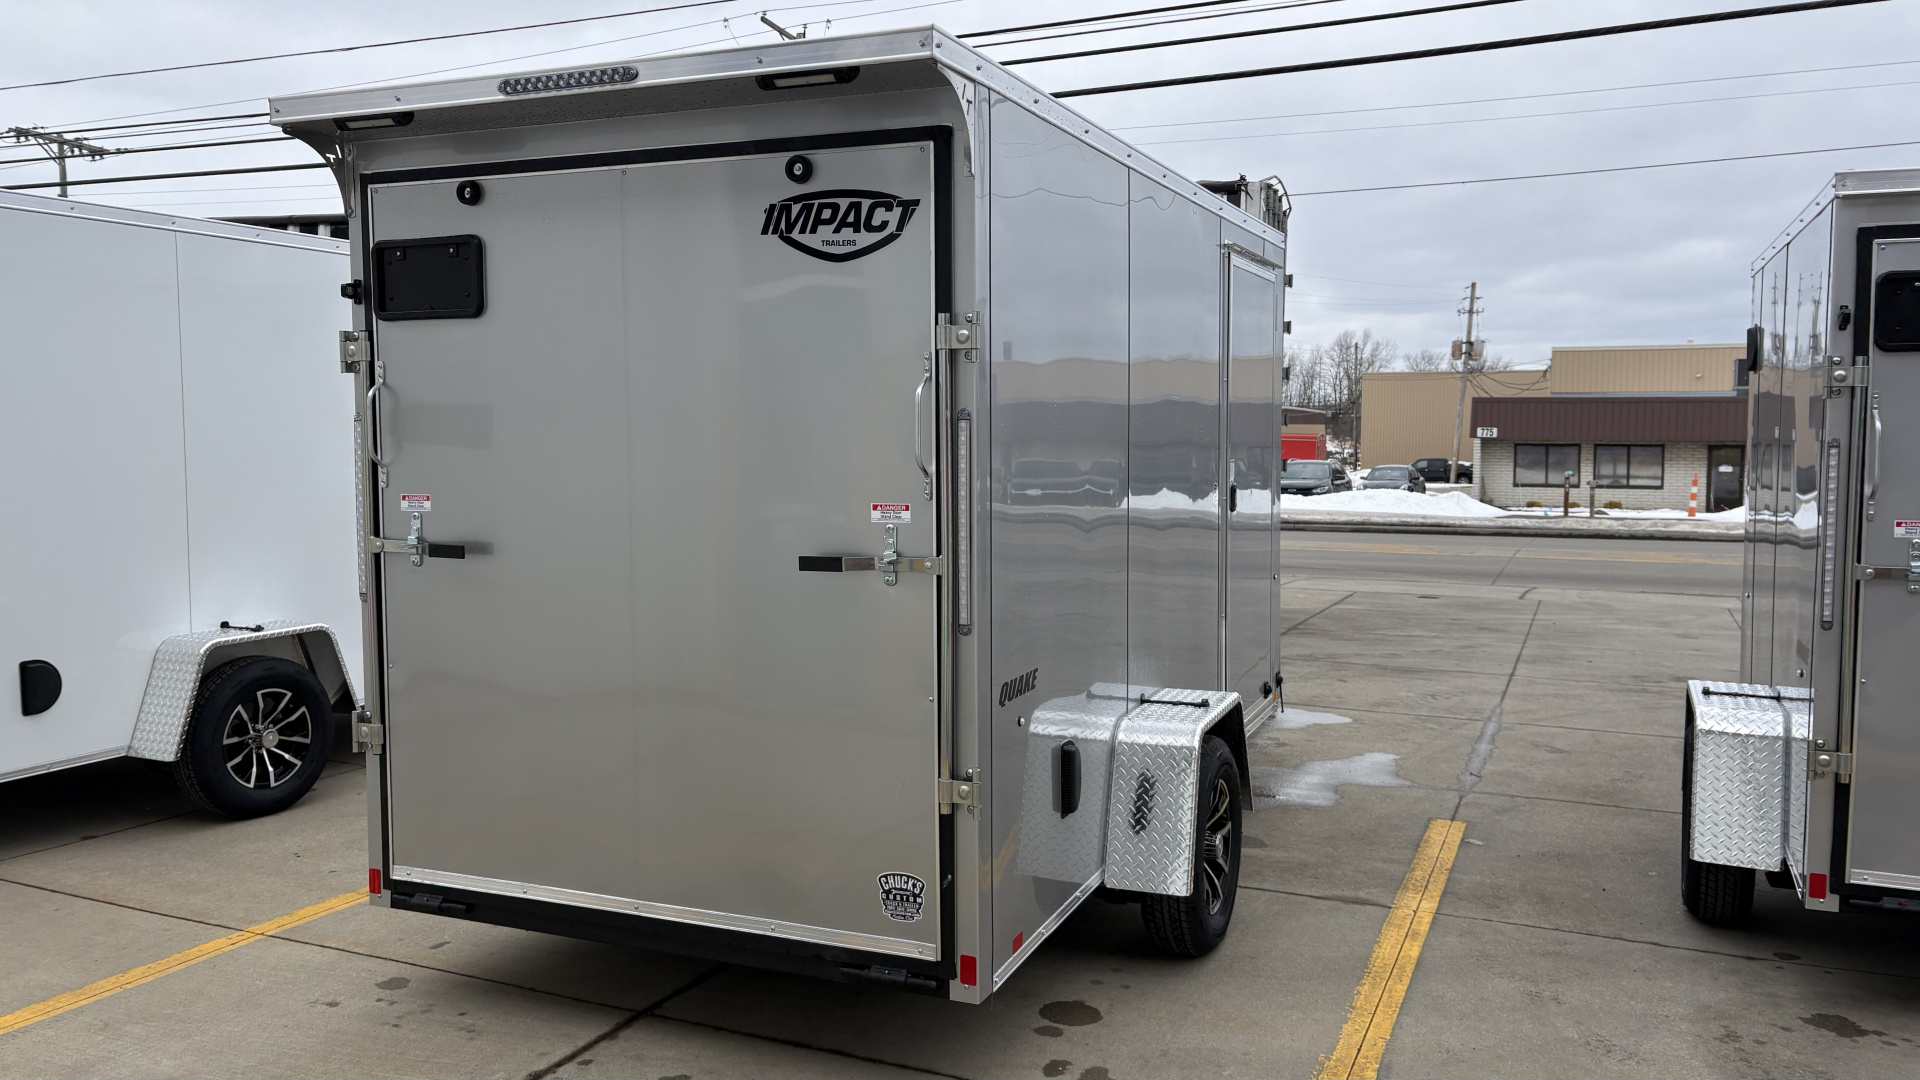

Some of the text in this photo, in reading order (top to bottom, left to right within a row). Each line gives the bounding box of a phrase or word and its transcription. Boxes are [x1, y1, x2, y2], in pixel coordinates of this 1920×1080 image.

[760, 198, 921, 236] IMPACT
[821, 239, 857, 247] TRAILERS
[1480, 428, 1494, 437] 775
[998, 667, 1039, 708] QUAKE
[880, 875, 923, 894] CHUCK'S
[882, 893, 922, 903] CUSTOM
